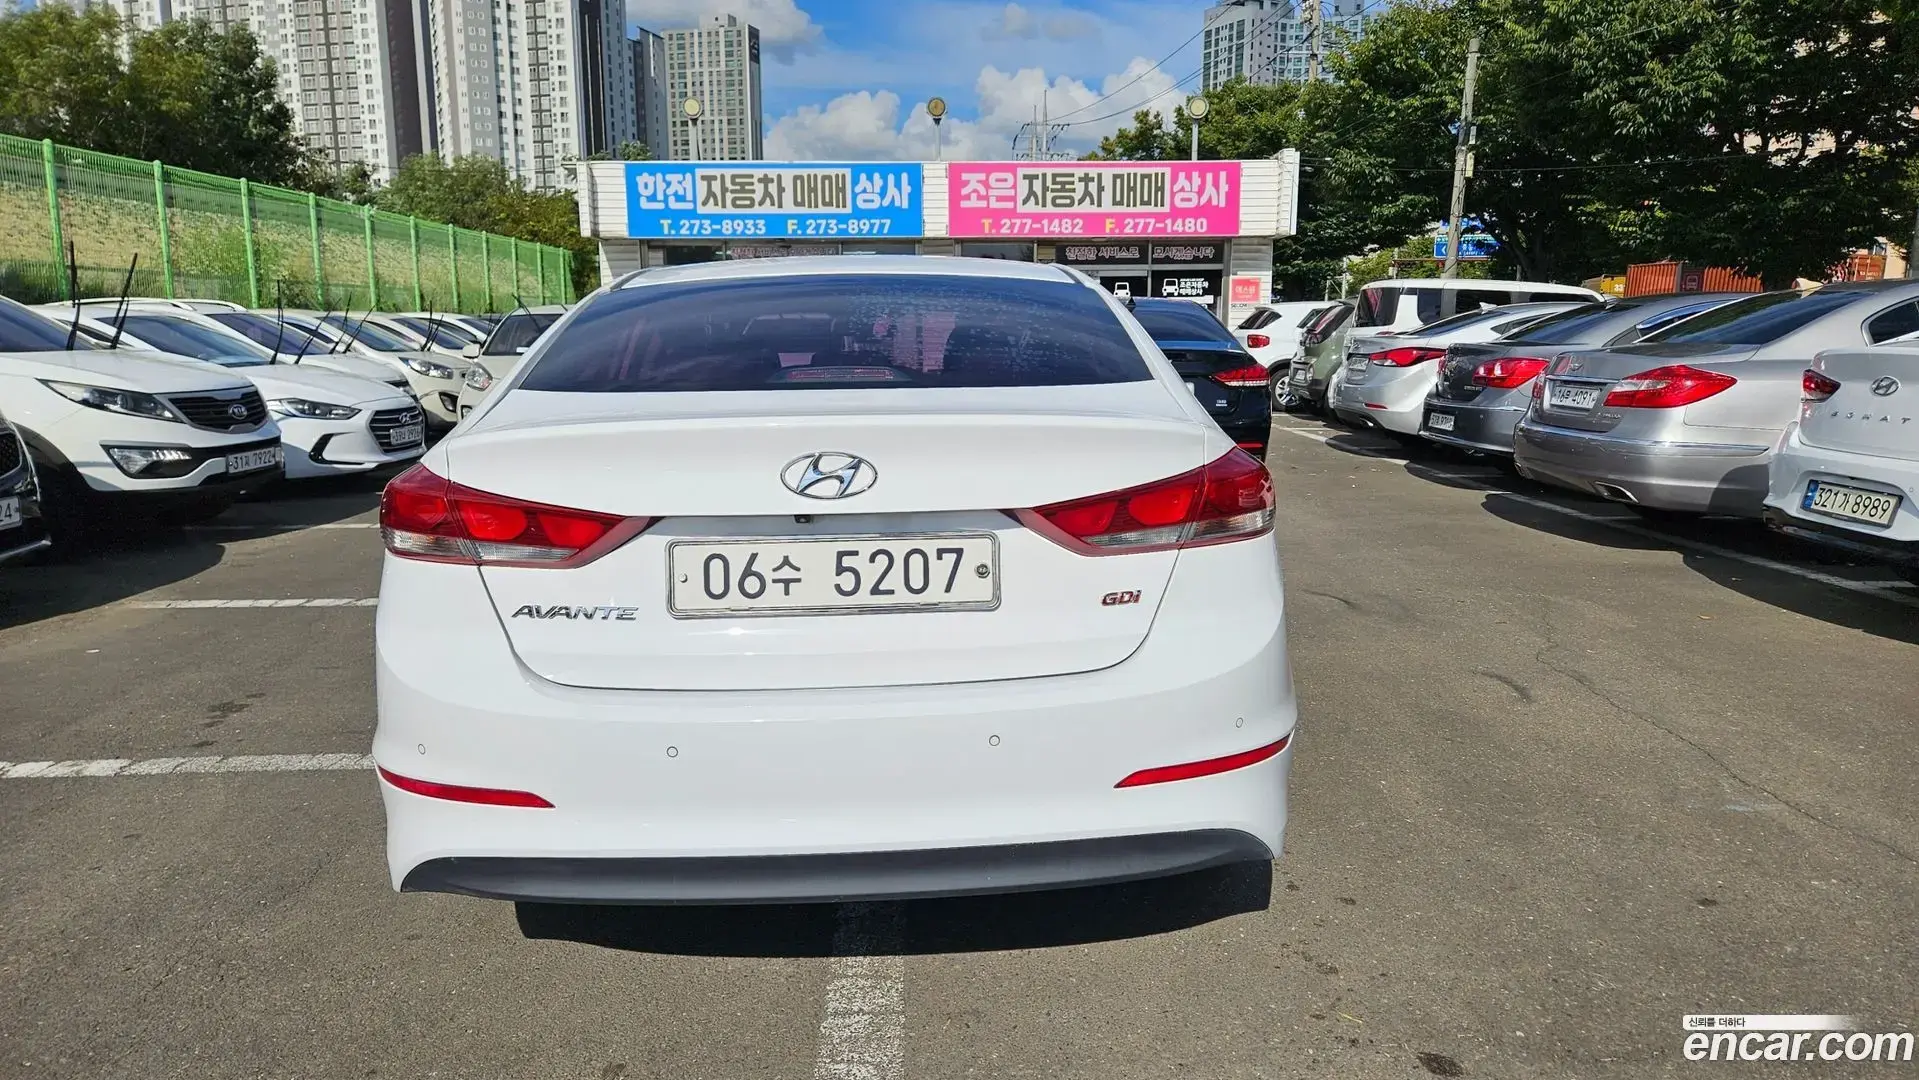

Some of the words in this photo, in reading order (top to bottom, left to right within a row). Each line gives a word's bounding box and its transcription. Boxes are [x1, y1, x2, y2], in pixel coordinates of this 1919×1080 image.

[637, 172, 694, 210] 한전
[700, 173, 785, 209] 자동차
[792, 173, 847, 208] 매매
[854, 172, 912, 209] 상사
[960, 172, 1015, 208] 조은
[1022, 172, 1104, 208] 자동차
[1112, 172, 1165, 207] 매매
[1173, 171, 1229, 208] 상사
[679, 219, 766, 234] 273-8933
[806, 219, 891, 234] 273-8977
[1000, 219, 1083, 233] 277-1482
[1124, 218, 1208, 233] 277-1480
[1066, 247, 1097, 260] 친절한
[1099, 247, 1140, 259] 서비스로
[1153, 246, 1215, 260] 모시겠습니다
[253, 450, 272, 466] 7922
[1851, 495, 1891, 519] 8989
[703, 552, 802, 600] 06수
[834, 547, 964, 597] 5207
[1101, 589, 1142, 607] GDi
[511, 604, 640, 621] AVANTE
